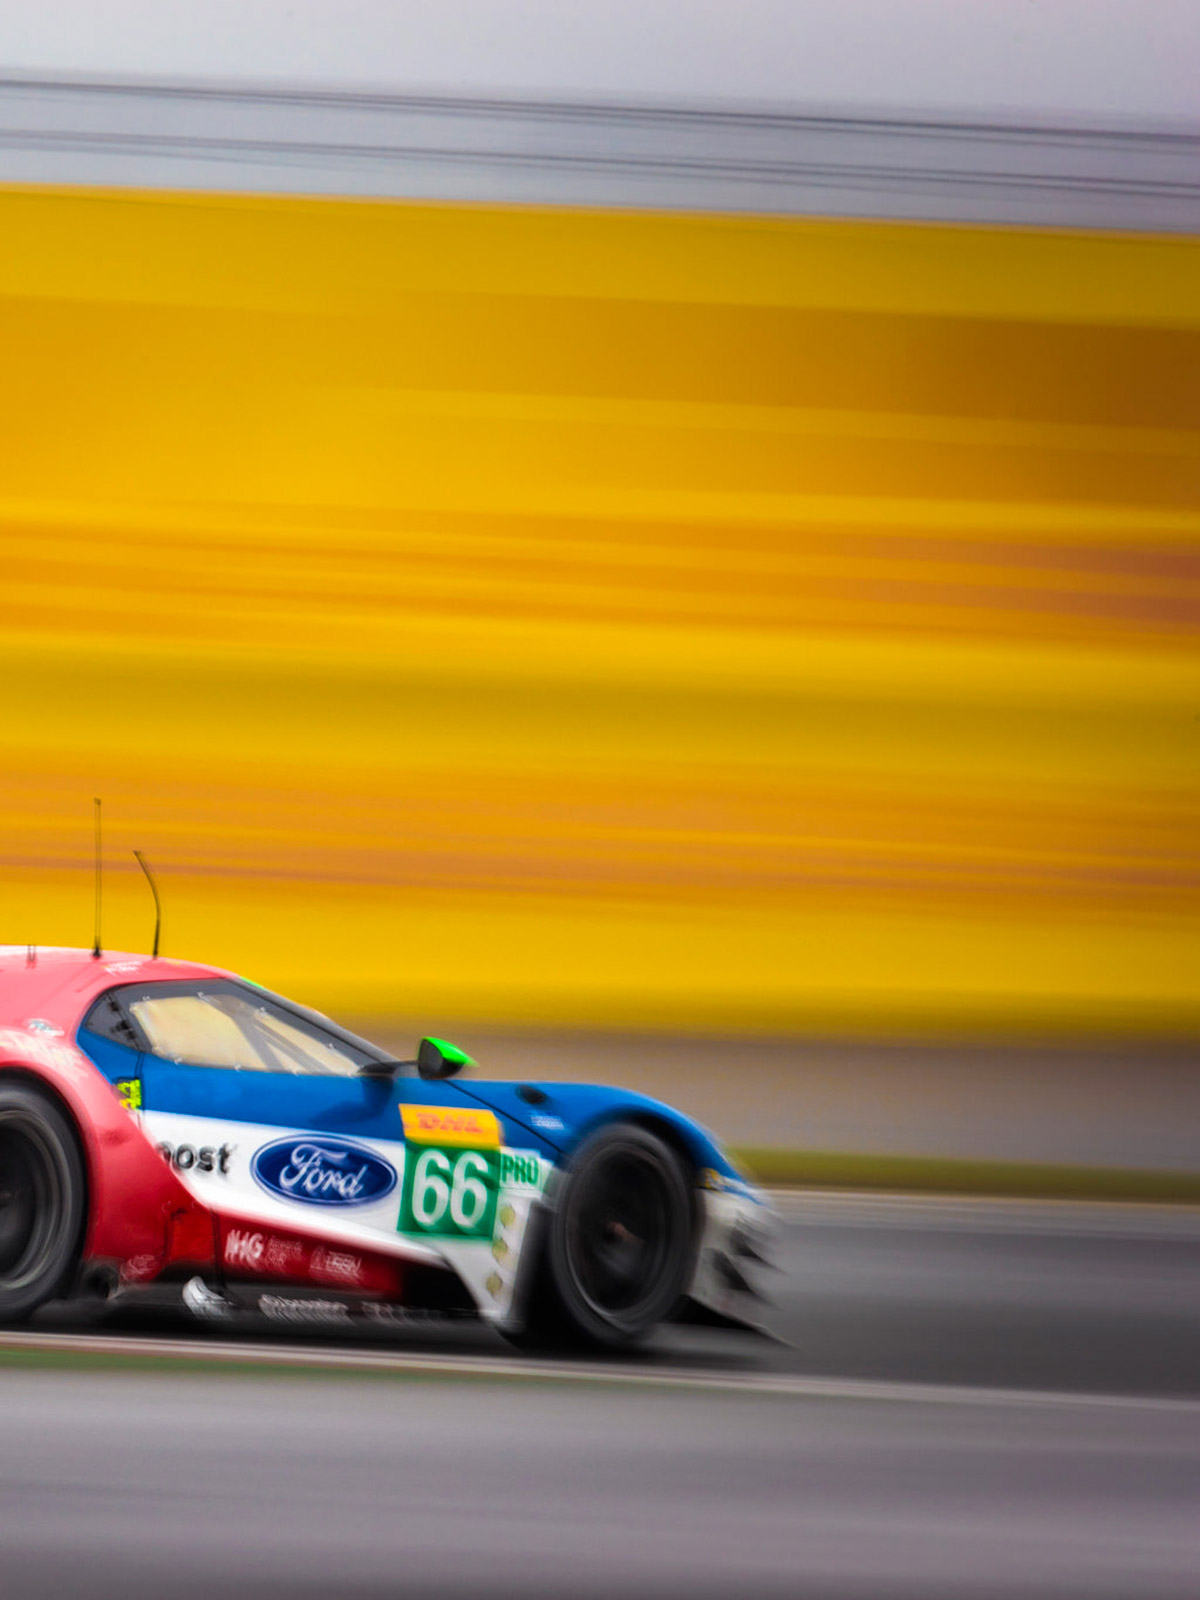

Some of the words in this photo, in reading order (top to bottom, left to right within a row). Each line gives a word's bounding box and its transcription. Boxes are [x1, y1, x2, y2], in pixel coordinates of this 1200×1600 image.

[417, 1112, 484, 1134] DHL
[279, 1143, 369, 1198] Ford
[412, 1148, 489, 1229] 66
[502, 1153, 540, 1184] PRO
